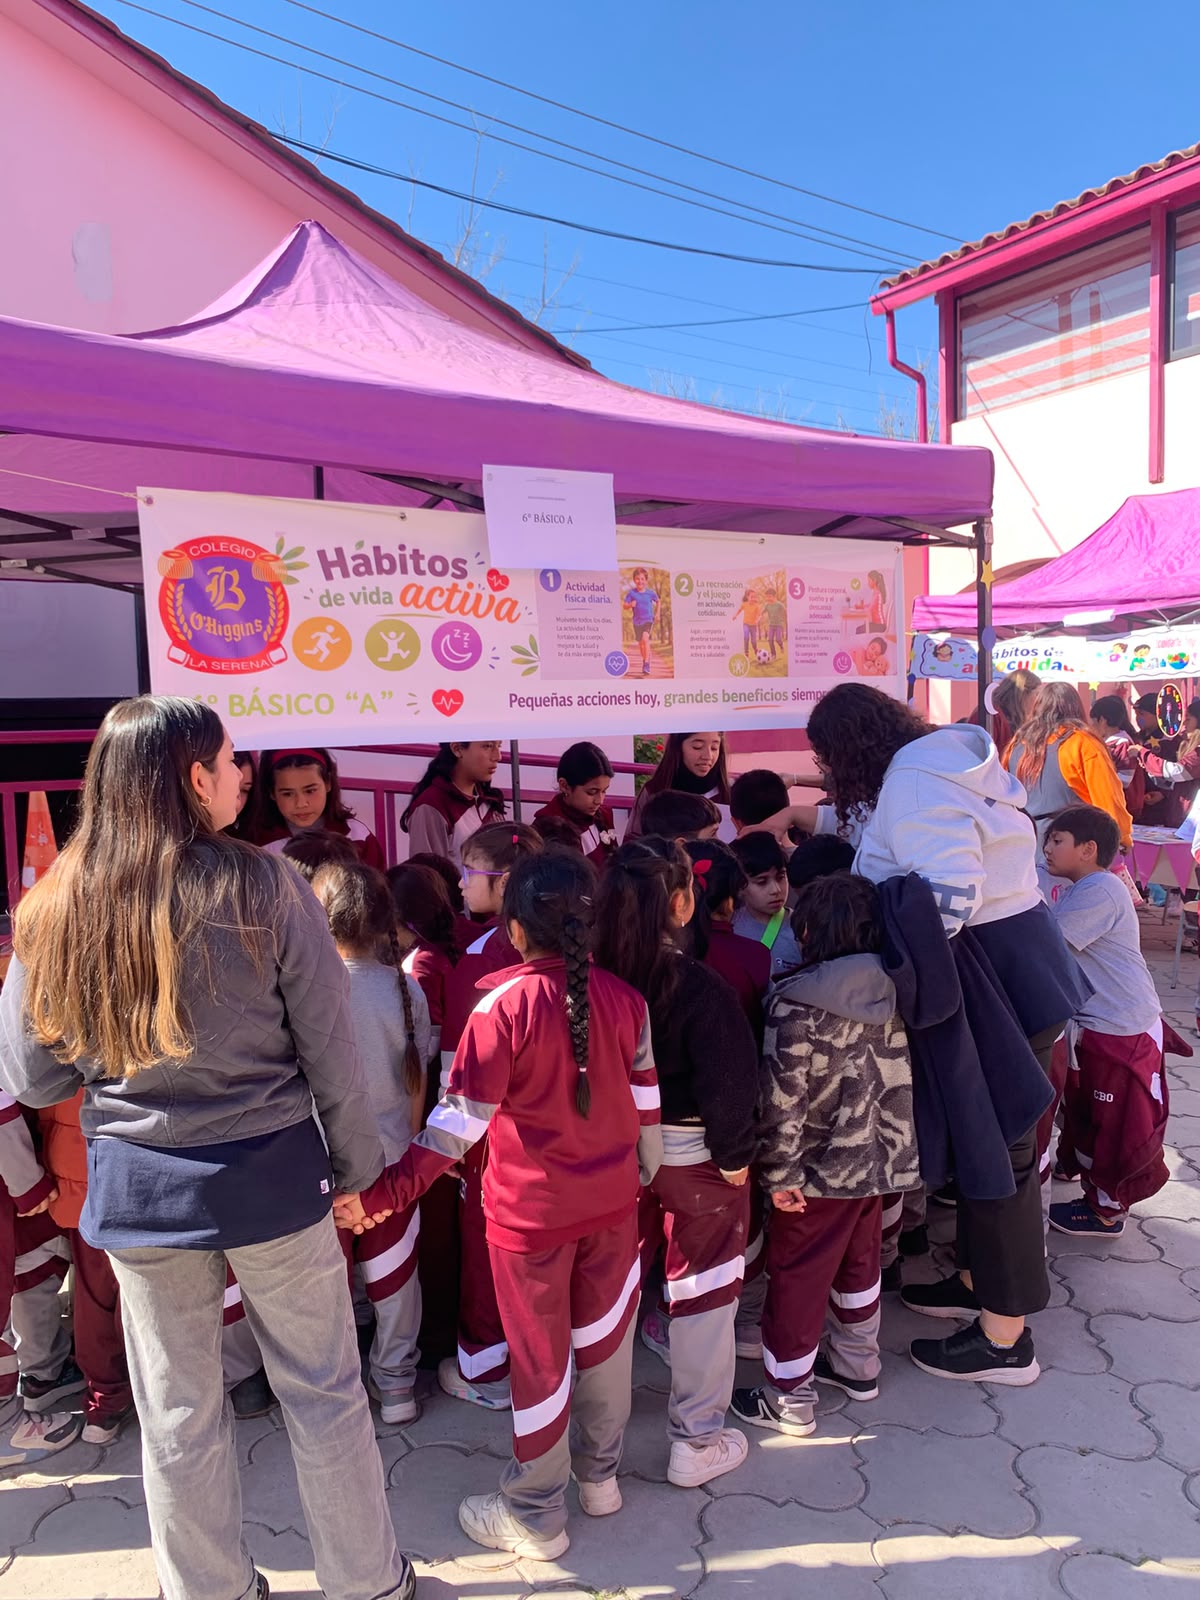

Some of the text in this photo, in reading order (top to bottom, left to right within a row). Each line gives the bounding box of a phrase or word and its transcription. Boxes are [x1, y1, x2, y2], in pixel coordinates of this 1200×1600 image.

[534, 512, 565, 525] BÁSICO
[567, 515, 574, 525] A
[189, 542, 256, 559] COLEGIO
[546, 571, 555, 588] 1
[680, 577, 689, 593] 2
[696, 578, 743, 589] La recreación
[565, 581, 606, 593] Actividad
[793, 582, 801, 596] 3
[564, 593, 613, 604] física diaria.
[696, 590, 731, 600] y el juego
[319, 581, 521, 624] de vida activa
[190, 611, 263, 642] O'Higgins
[189, 657, 270, 671] LA SERENA
[228, 687, 335, 717] BÁSICO
[509, 691, 573, 711] Pequeñas
[577, 691, 631, 706] acciones
[634, 690, 660, 709] hoy,
[664, 689, 718, 707] grandes
[722, 687, 788, 703] beneficios
[1093, 1089, 1114, 1103] CBO
